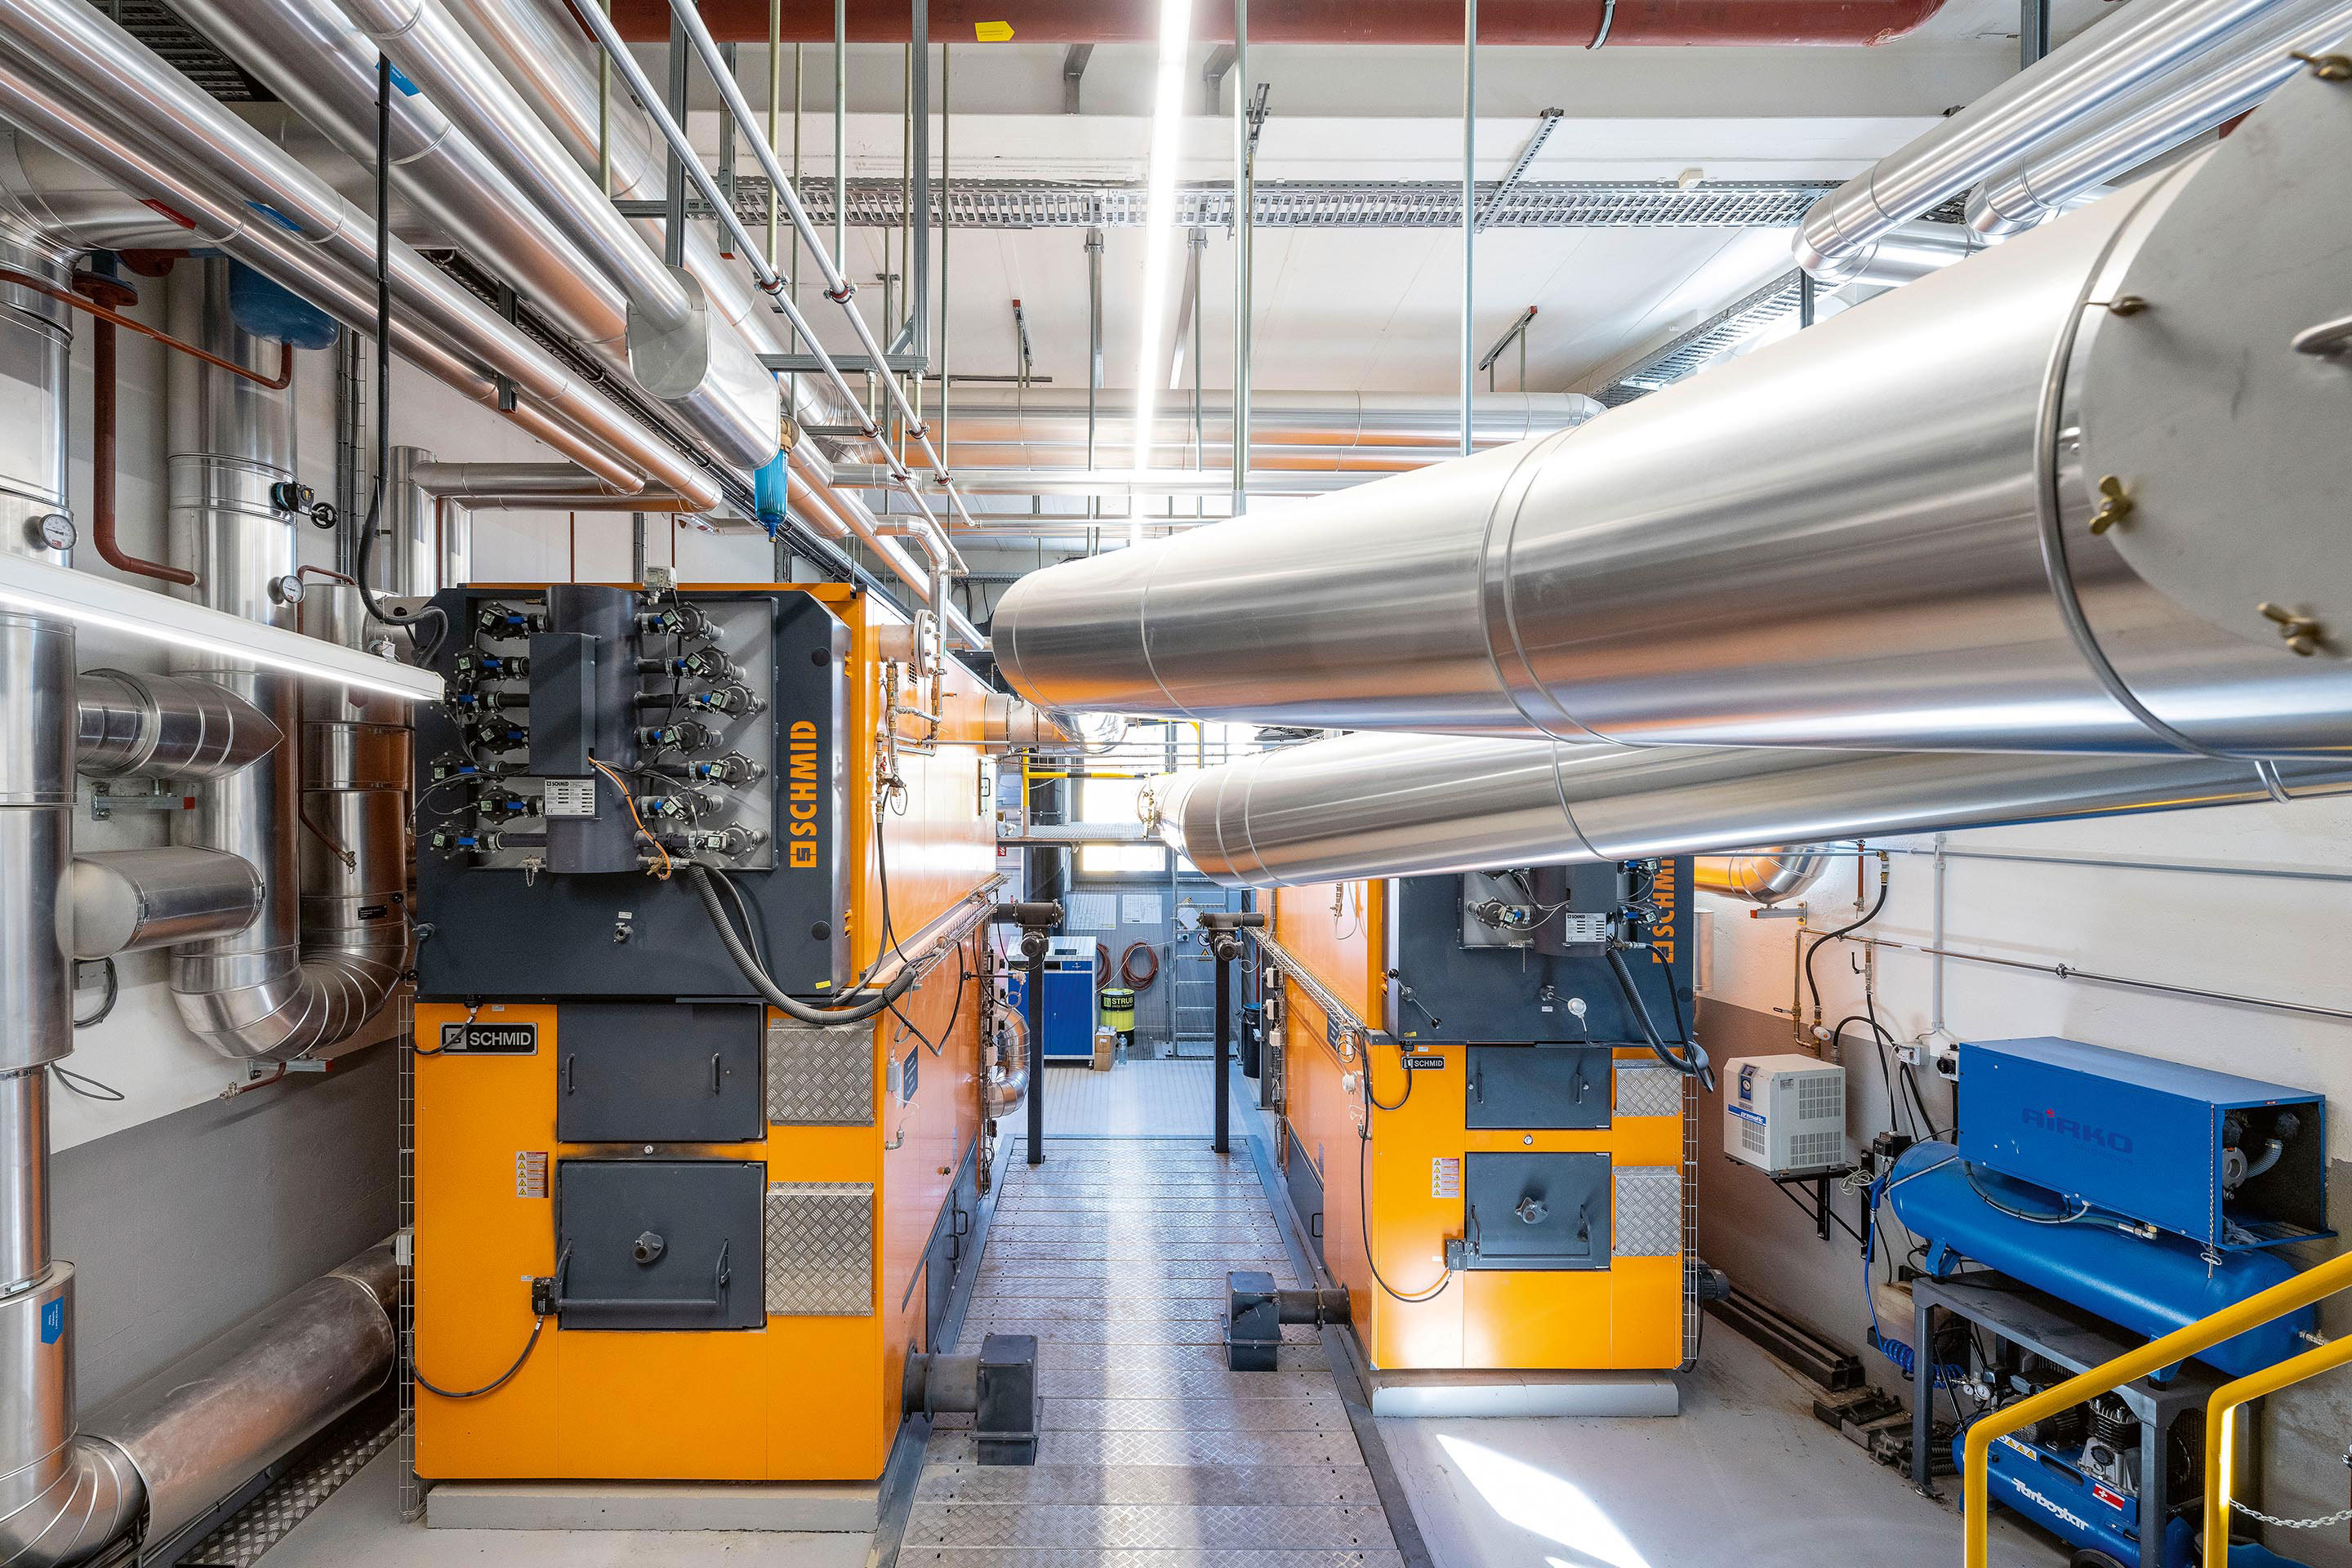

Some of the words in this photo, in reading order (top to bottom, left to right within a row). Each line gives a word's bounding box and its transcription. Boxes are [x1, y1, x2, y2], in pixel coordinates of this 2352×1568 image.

[790, 720, 817, 836] SCHMID
[1652, 860, 1674, 937] SCHMI
[470, 1032, 532, 1045] SCHMID
[2012, 1477, 2090, 1530] Turbostar
